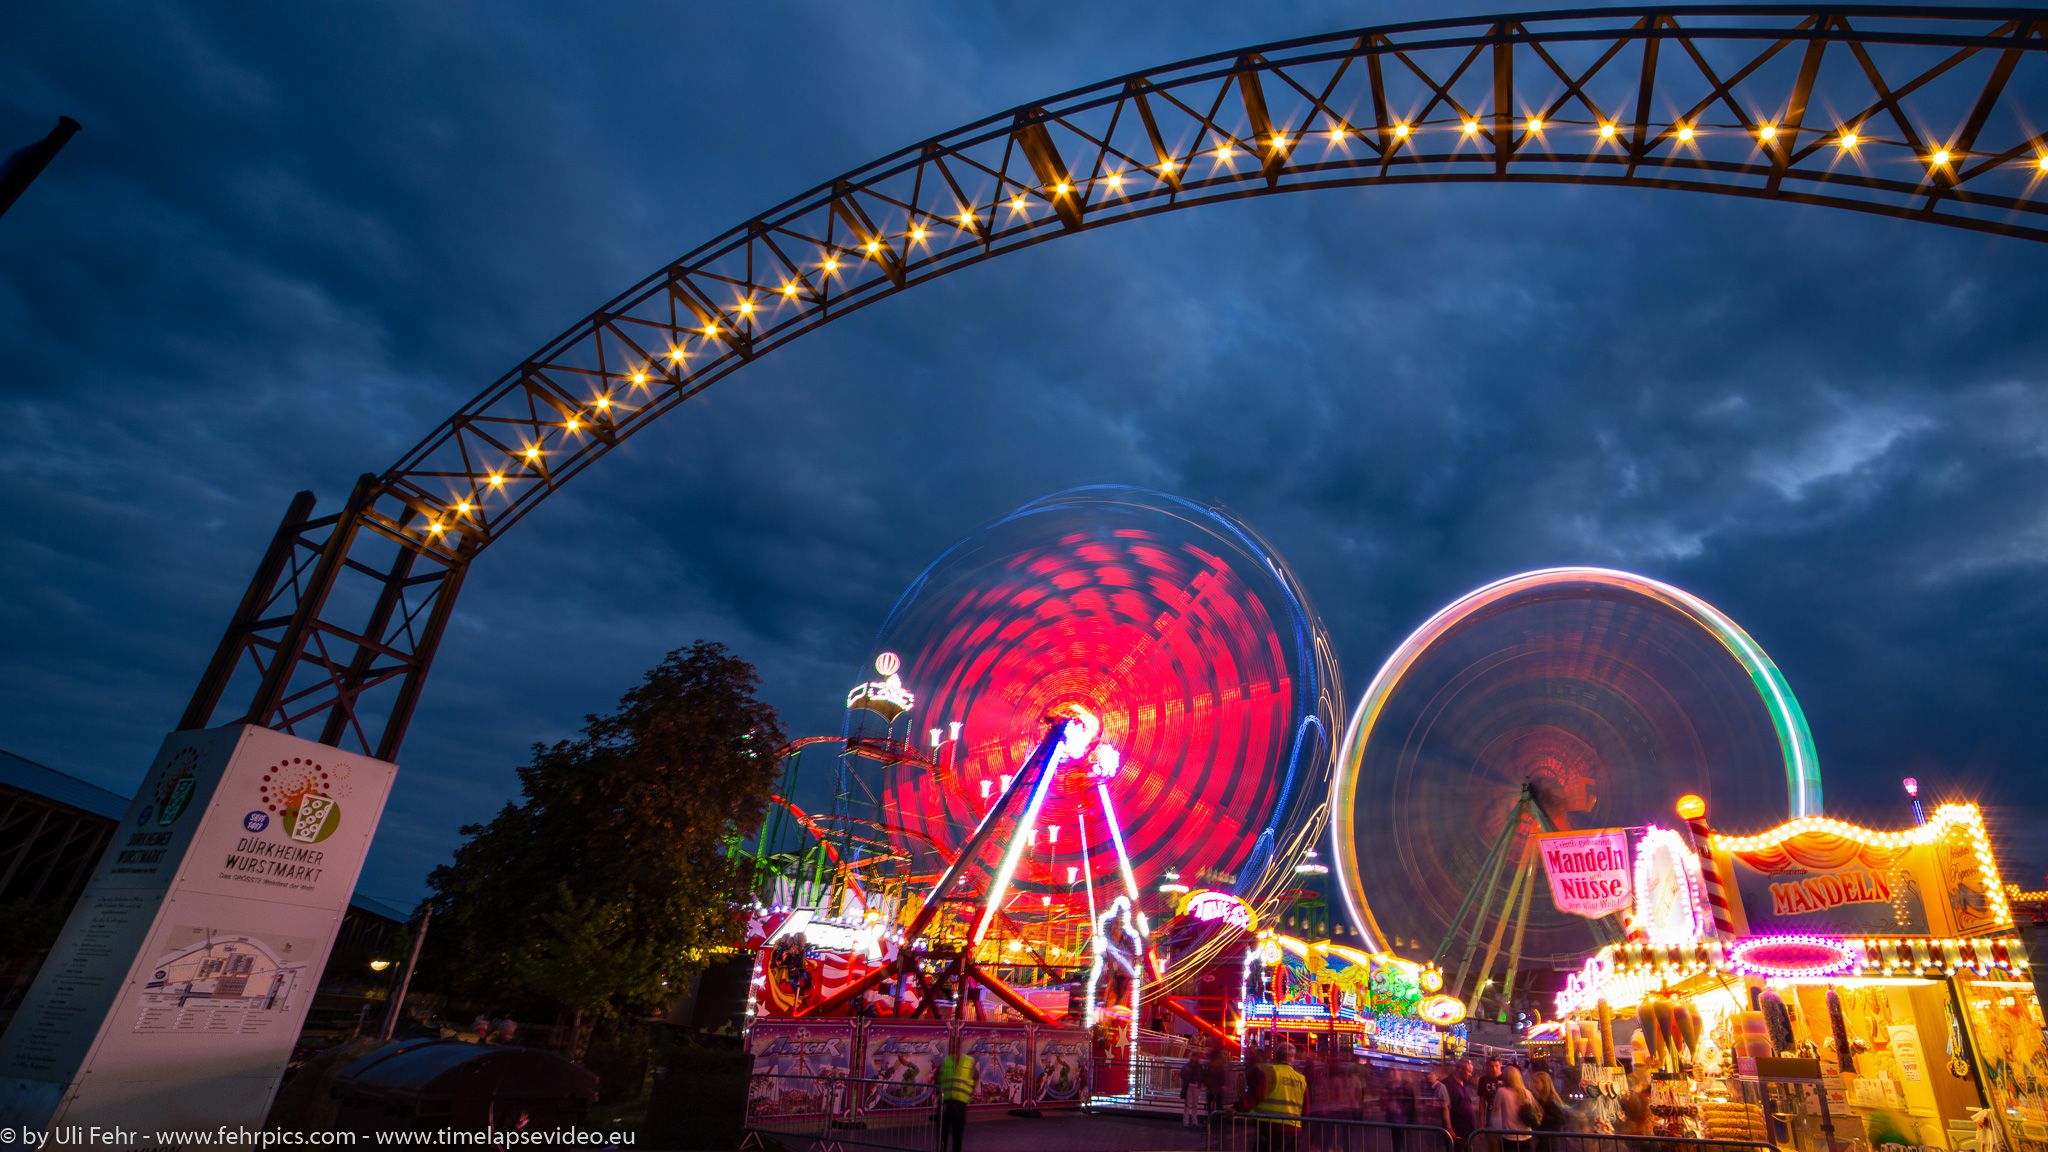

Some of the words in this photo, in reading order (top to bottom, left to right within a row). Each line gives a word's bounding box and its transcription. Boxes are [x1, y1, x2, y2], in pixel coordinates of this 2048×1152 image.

[237, 837, 324, 865] DÜRKHEIMER
[1547, 847, 1625, 873] Mandeln
[225, 854, 323, 882] WURSTMARKT
[1560, 877, 1623, 899] Nüsse
[1769, 870, 1892, 916] MANDELN
